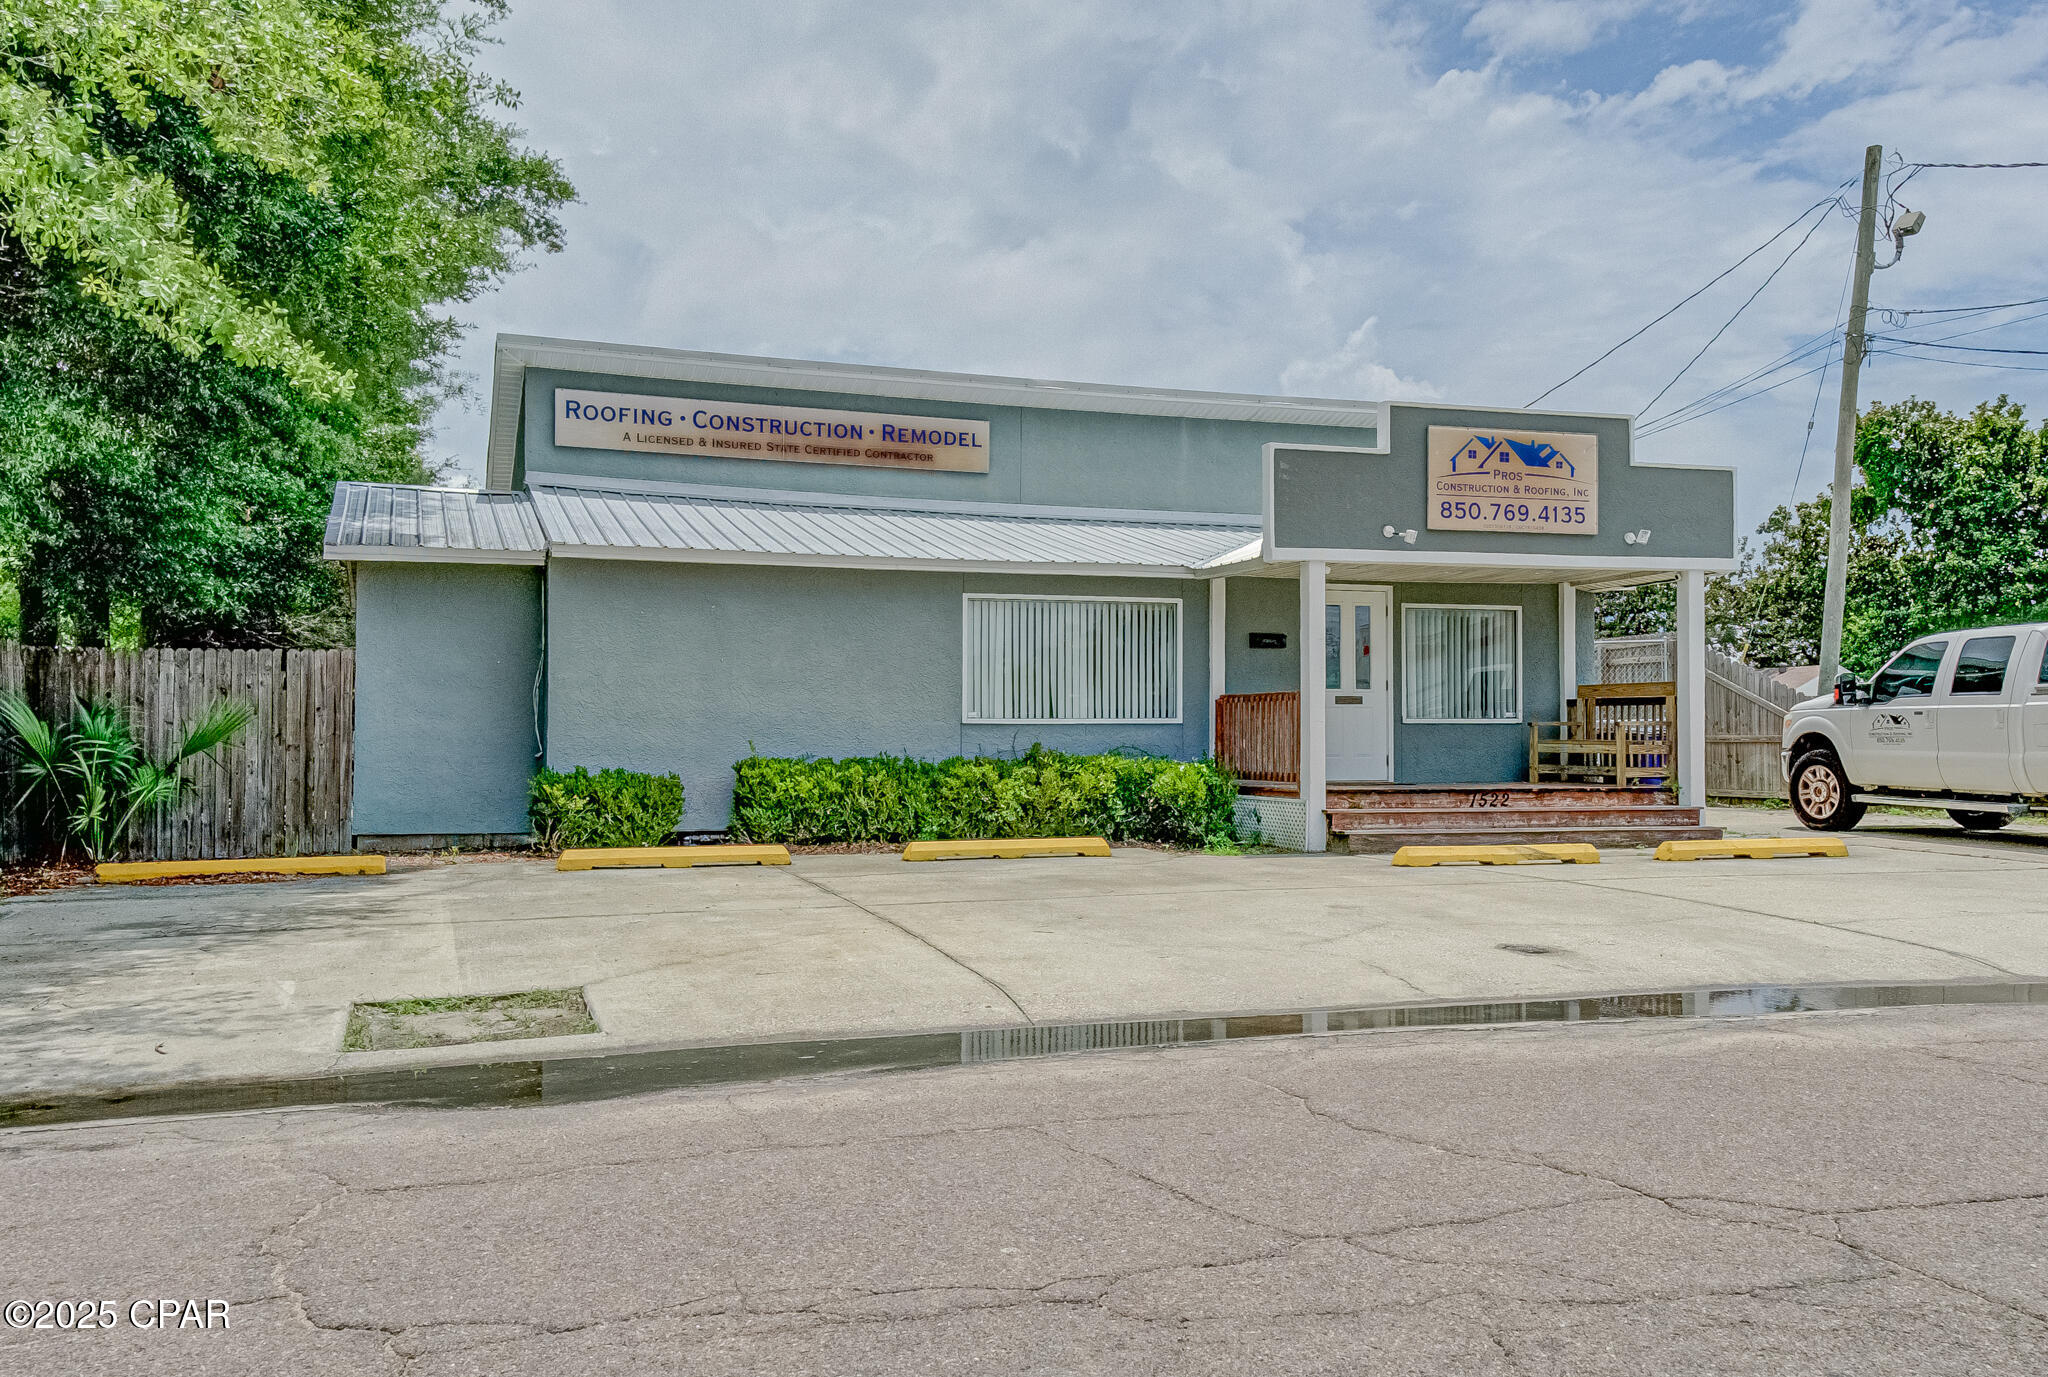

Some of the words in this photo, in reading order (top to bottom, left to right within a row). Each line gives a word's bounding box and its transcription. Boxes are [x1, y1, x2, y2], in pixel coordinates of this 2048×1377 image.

[565, 400, 673, 426] ROOFING
[692, 410, 863, 440] CONSTRUCTION
[882, 424, 983, 448] REMODEL
[622, 432, 631, 442] A
[637, 433, 694, 447] LICENSED
[699, 438, 707, 447] &
[712, 438, 762, 451] INSURED
[766, 442, 800, 454] STATE
[805, 445, 861, 457] CERTIFIED
[865, 449, 934, 462] CONTRACTOR
[1493, 469, 1523, 481] PROS
[1436, 481, 1510, 494] CONSTRUCTION
[1514, 484, 1521, 494] &
[1524, 485, 1569, 497] ROOFING,
[1573, 487, 1589, 497] INC
[1440, 501, 1586, 524] 850.769.4135
[1469, 792, 1509, 808] 1522
